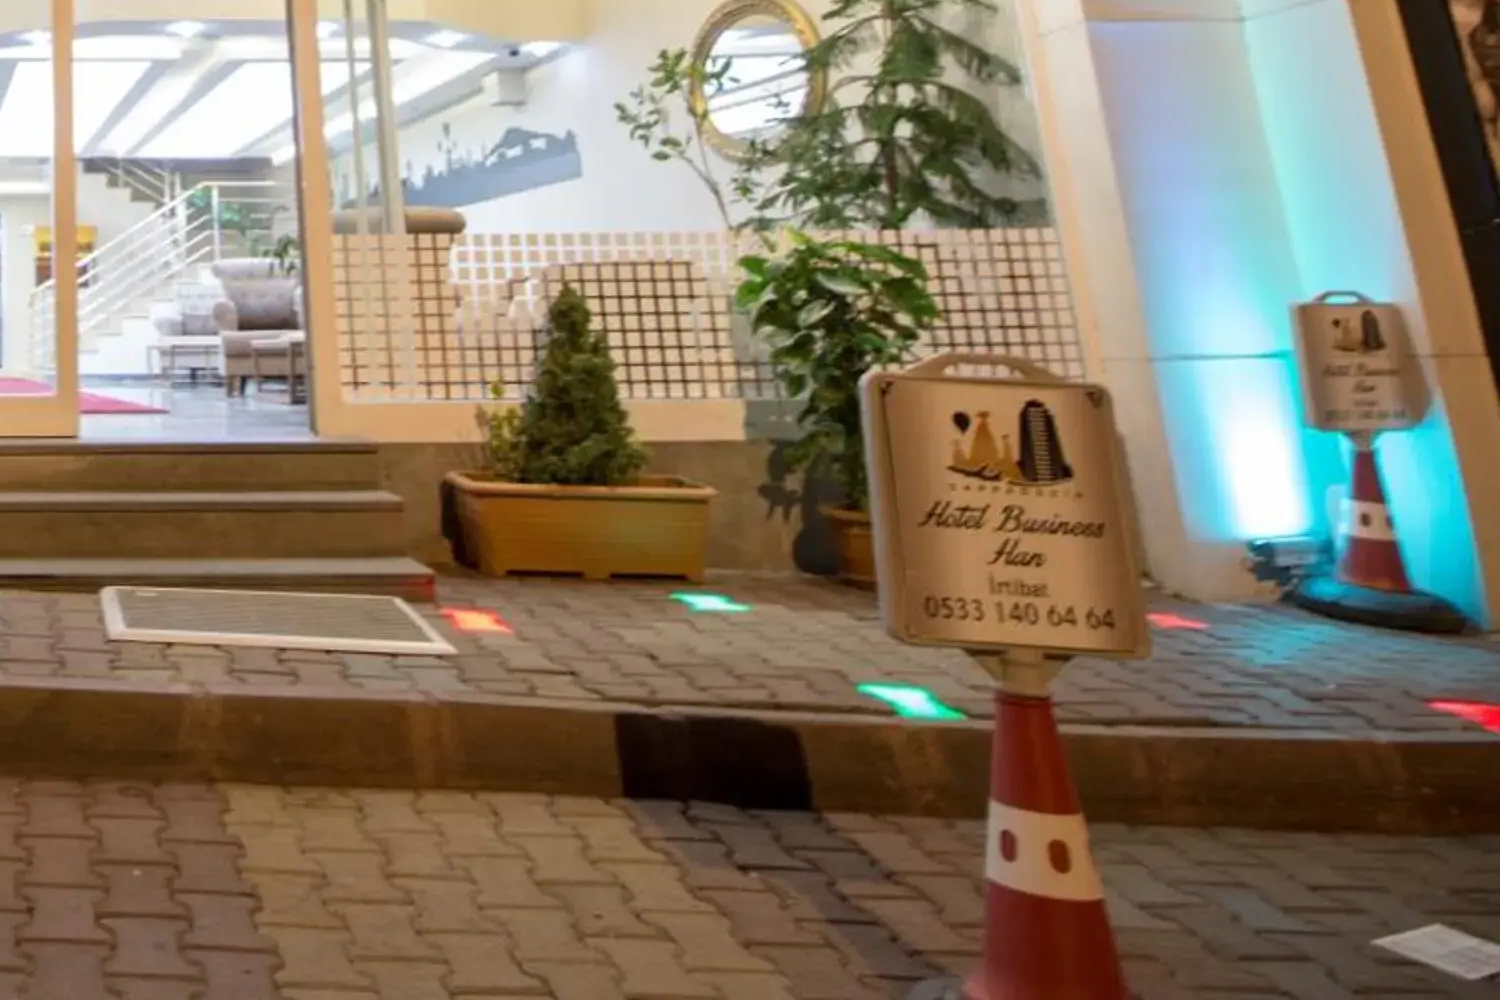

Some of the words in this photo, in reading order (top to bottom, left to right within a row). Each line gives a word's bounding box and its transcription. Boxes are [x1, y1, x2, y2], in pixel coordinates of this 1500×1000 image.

[917, 500, 991, 530] Hotel
[993, 503, 1106, 538] Business
[986, 537, 1047, 568] Han
[923, 595, 986, 622] 0533
[994, 600, 1040, 625] 140
[1046, 604, 1078, 628] 64
[1084, 606, 1117, 631] 64
